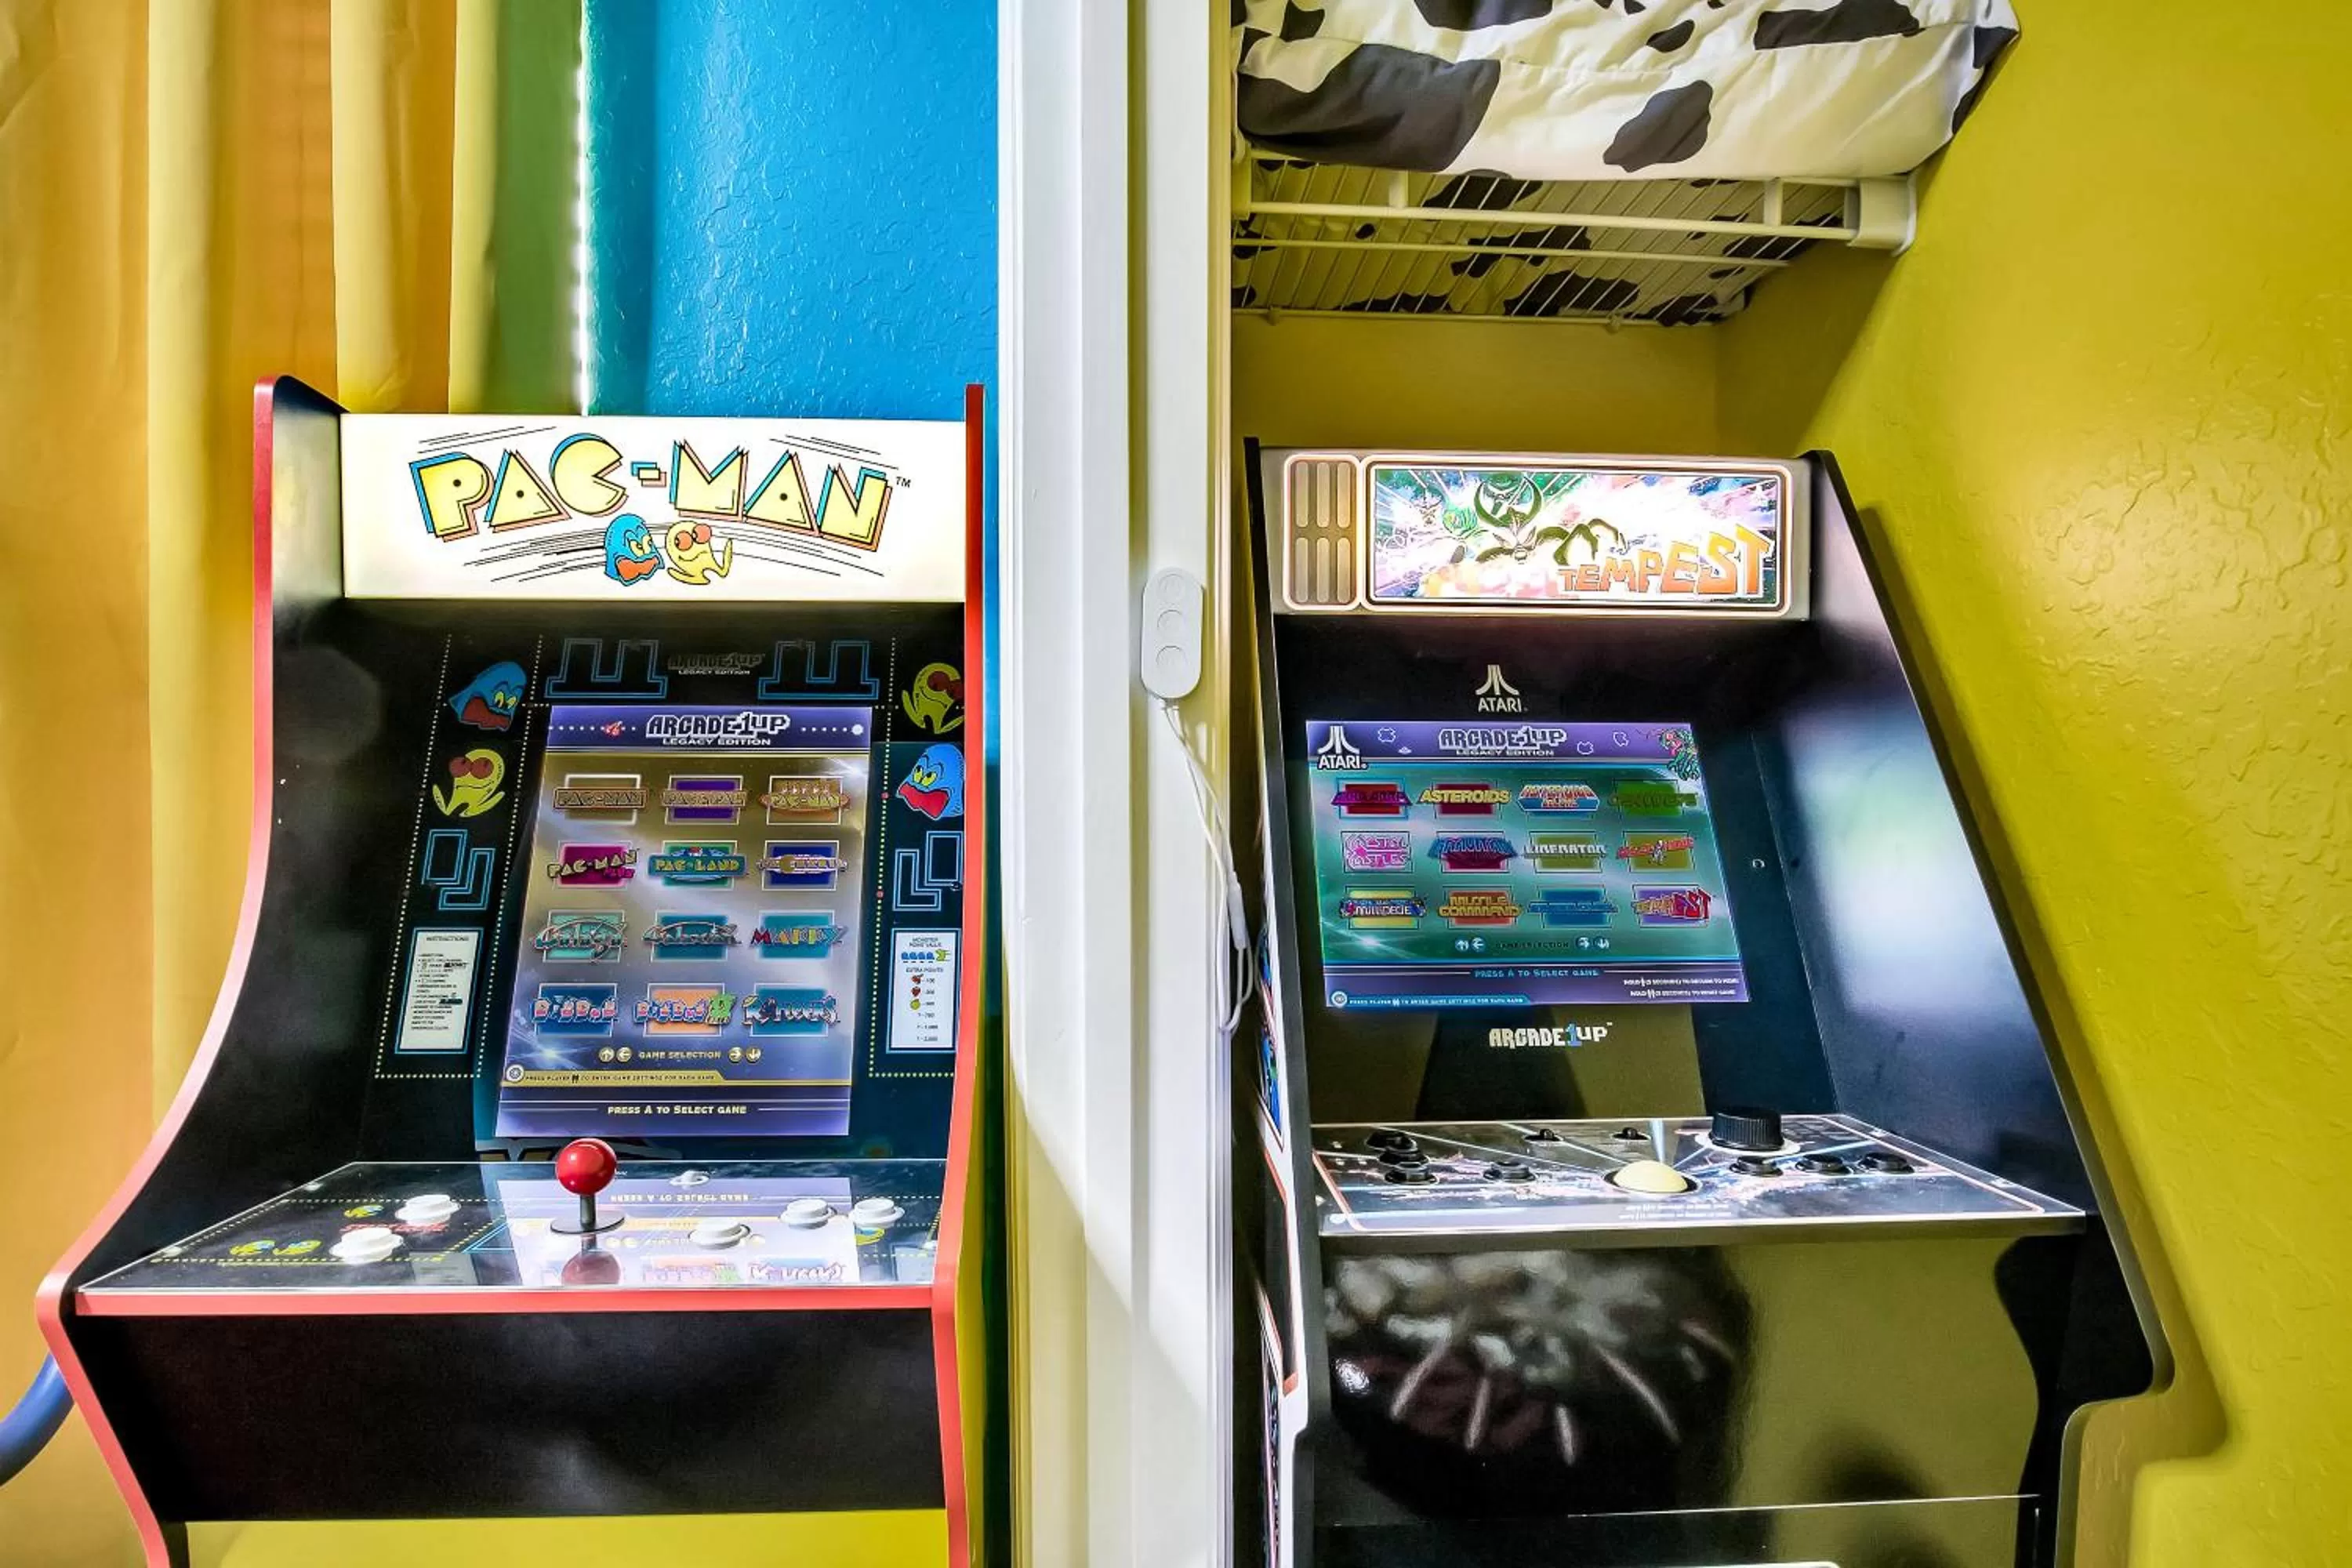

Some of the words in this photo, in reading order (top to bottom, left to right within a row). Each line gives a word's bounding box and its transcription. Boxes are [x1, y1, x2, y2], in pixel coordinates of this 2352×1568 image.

[408, 433, 895, 553] PAC-MAN
[1558, 523, 1771, 596] TEMPEST
[1478, 697, 1522, 713] ATARI
[1317, 755, 1362, 770] ATARI
[1419, 789, 1512, 804] ASTEROIDS
[1474, 969, 1504, 978] PRESS
[638, 1051, 666, 1059] GAME
[667, 1051, 721, 1059] SELECTION
[608, 1105, 641, 1114] PRESS
[644, 1105, 652, 1114] A
[656, 1105, 670, 1114] TO
[673, 1105, 714, 1114] SELECT
